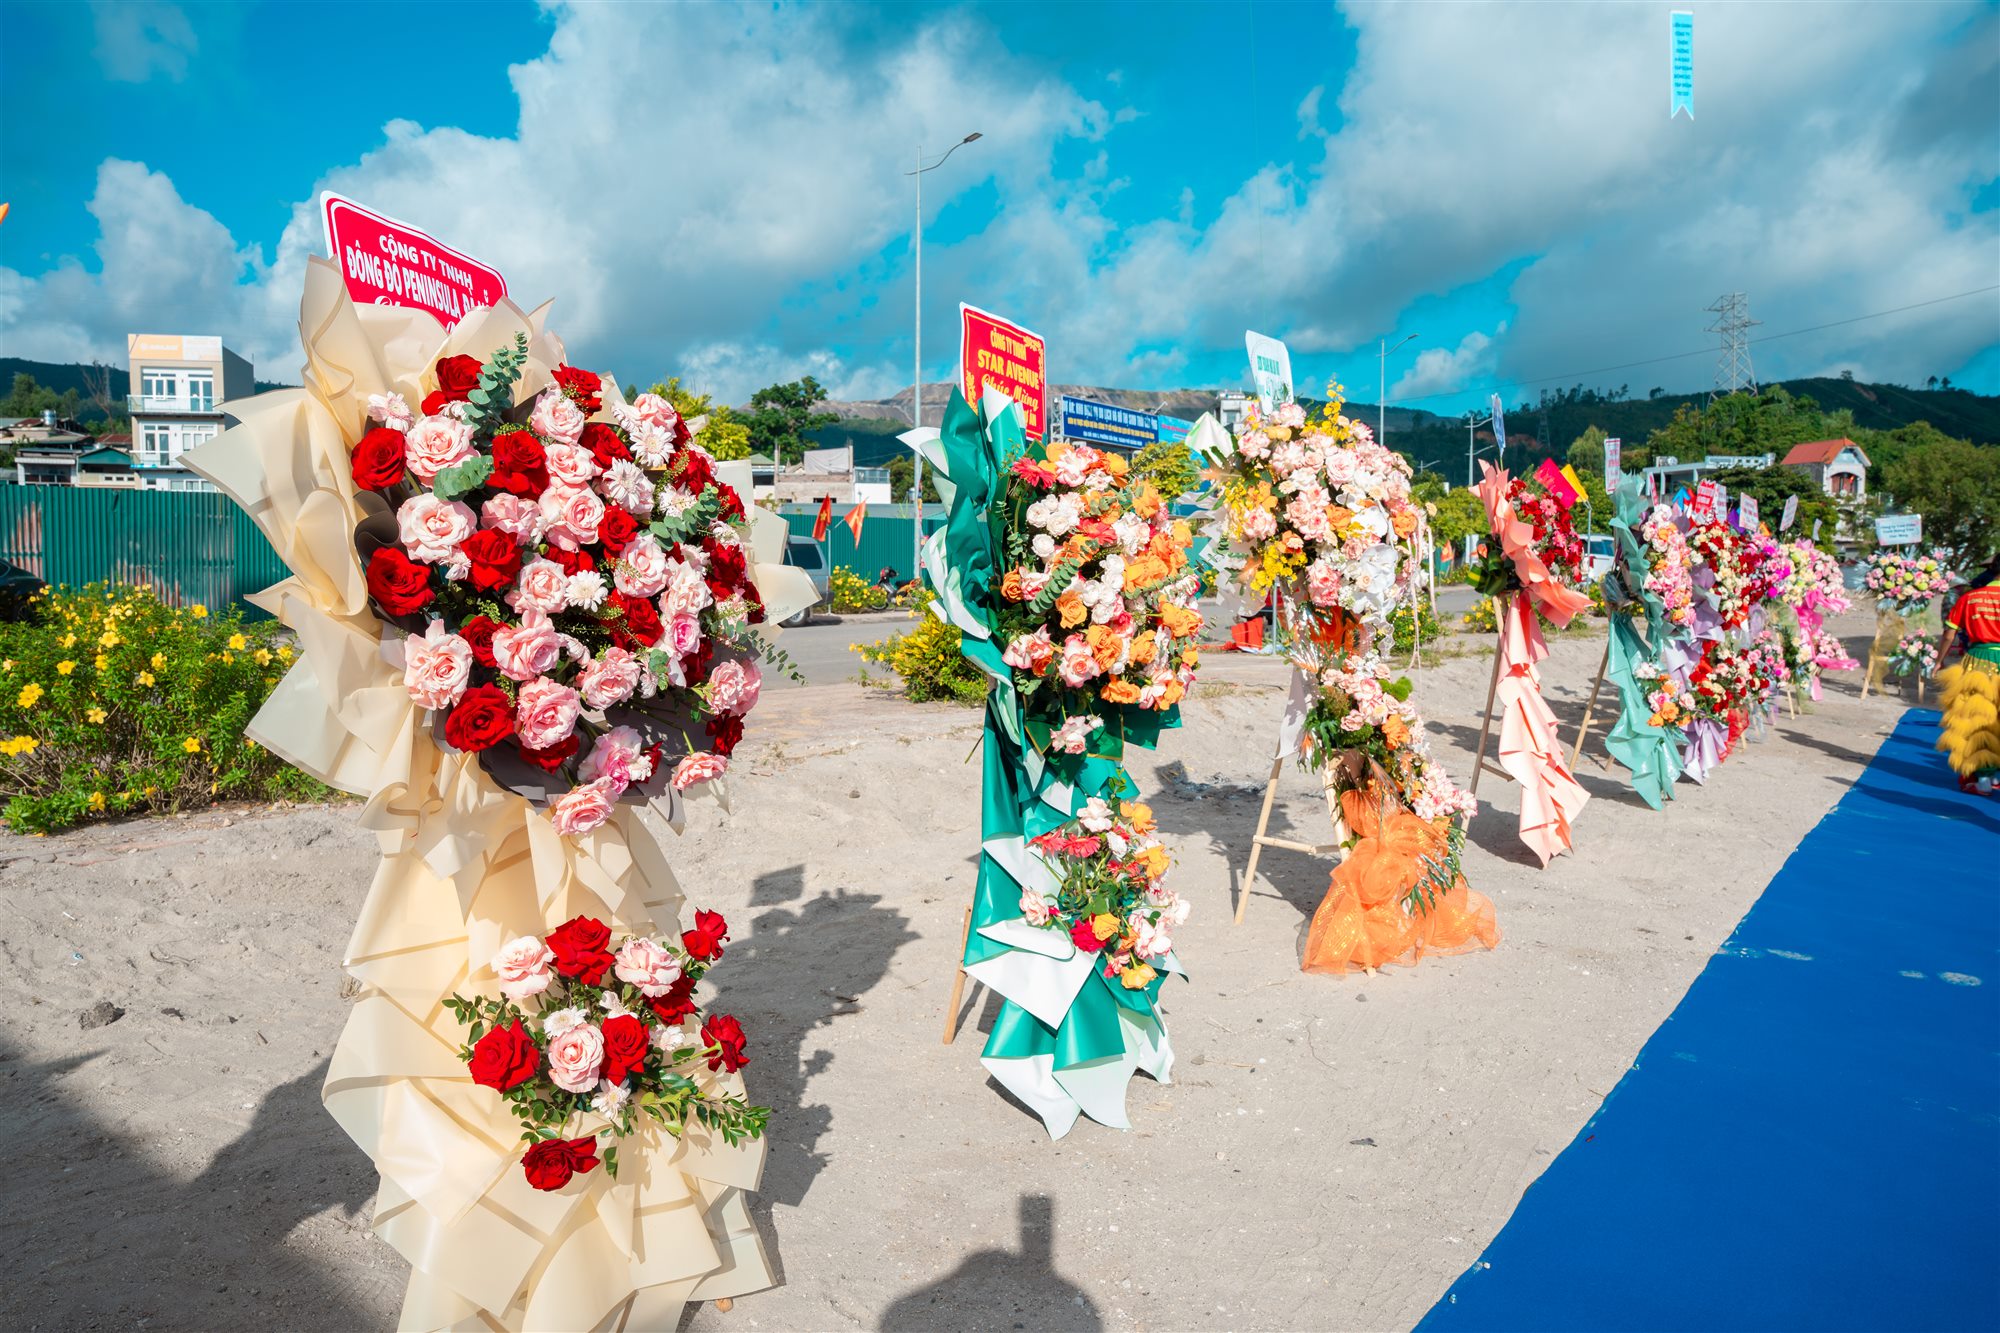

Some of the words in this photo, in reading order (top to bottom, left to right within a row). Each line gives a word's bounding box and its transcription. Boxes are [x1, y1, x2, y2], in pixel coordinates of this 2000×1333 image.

[345, 239, 384, 289] ĐÔNG
[402, 266, 462, 320] PENINSULA
[379, 233, 419, 264] CÔNG
[420, 250, 437, 271] TY
[438, 258, 473, 290] TNHH
[977, 349, 1005, 376] STAR
[1006, 360, 1040, 391] AVENUE
